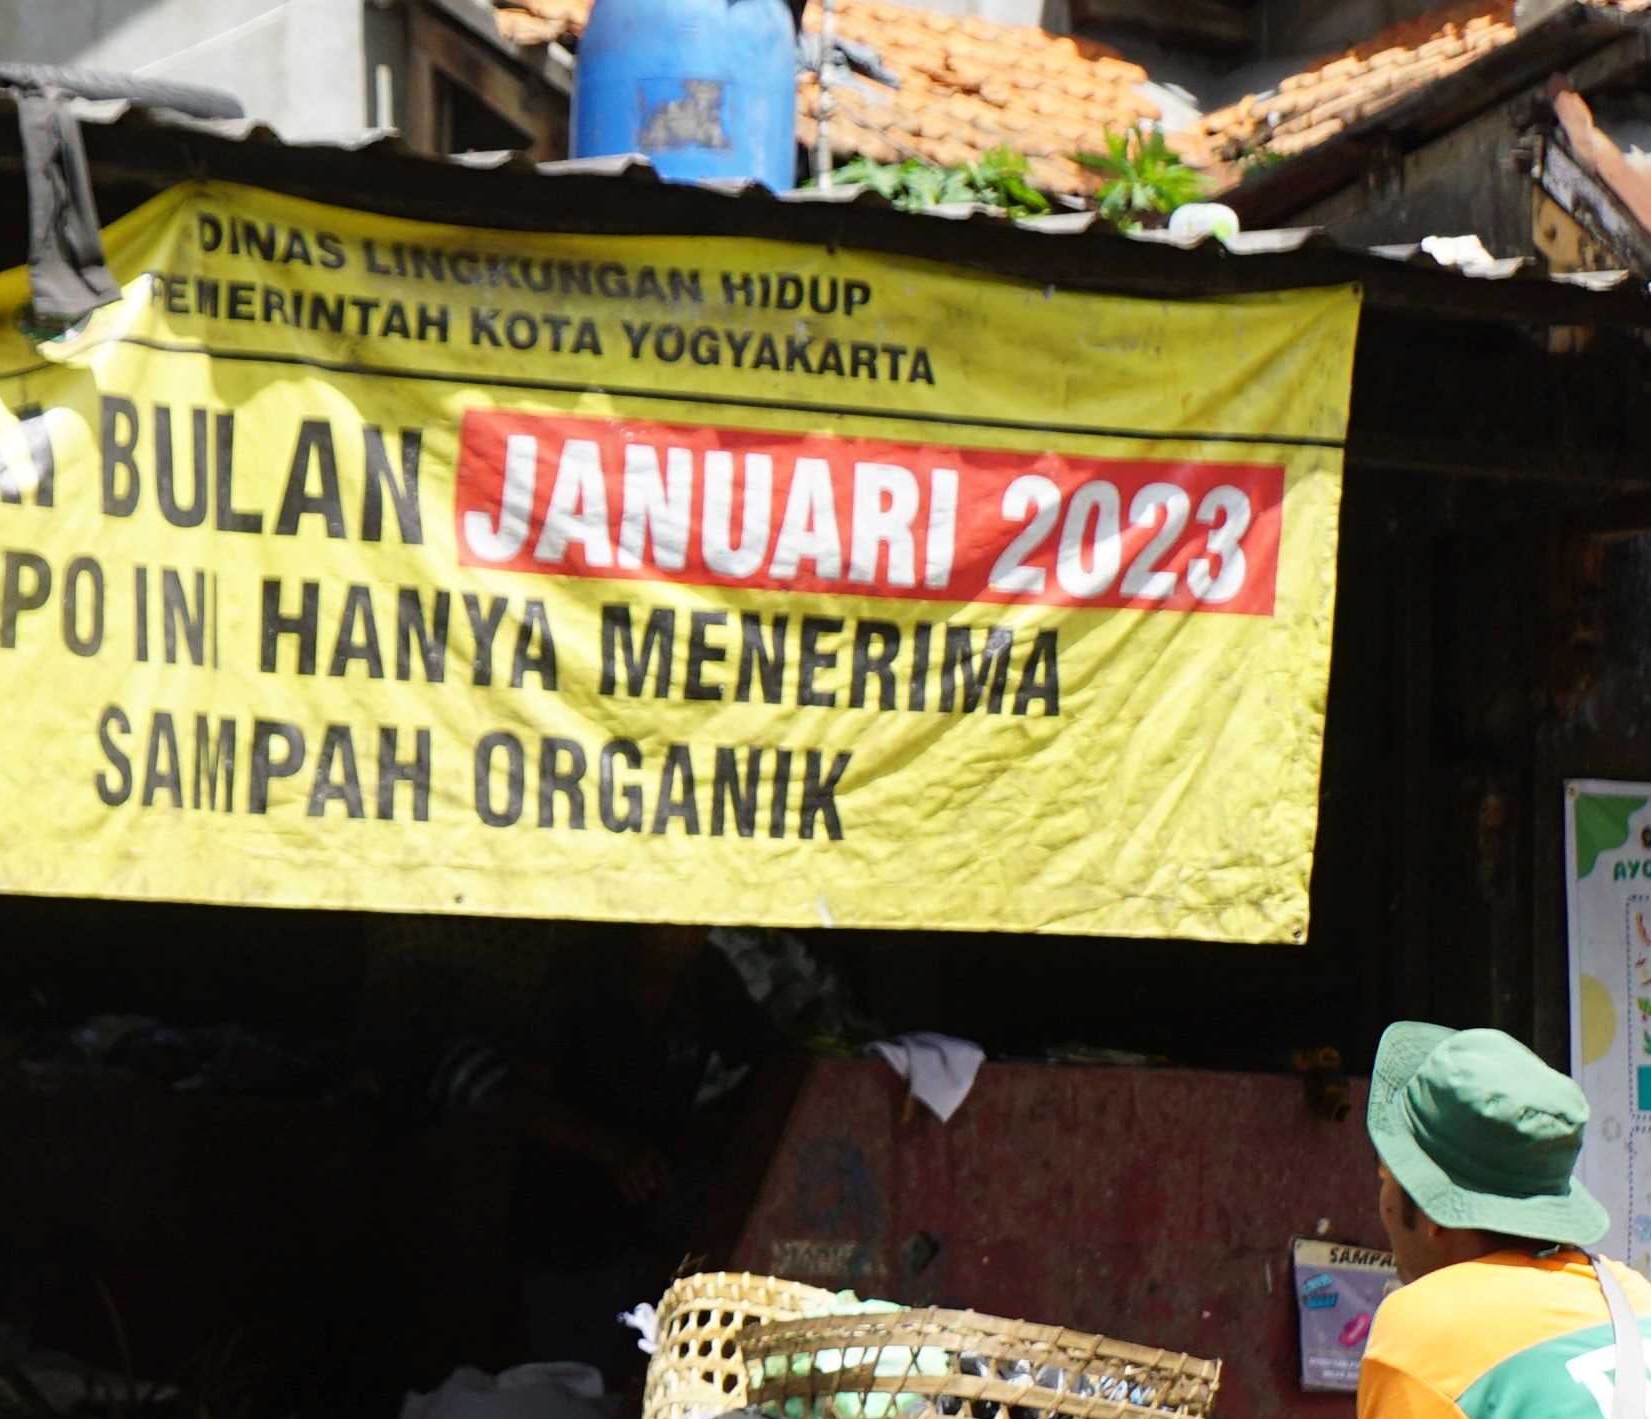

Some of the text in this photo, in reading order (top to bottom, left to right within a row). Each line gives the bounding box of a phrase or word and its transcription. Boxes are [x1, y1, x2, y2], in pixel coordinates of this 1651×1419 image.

[199, 211, 872, 318] DINAS LINGKUNGAN HIDUP
[469, 311, 602, 360] KOTA
[628, 319, 936, 387] YOGYAKARTA
[100, 395, 424, 545] BULAN
[463, 433, 959, 592] JANUARI
[986, 473, 1252, 606] 2023
[260, 577, 559, 694] HANYA
[599, 605, 1063, 718] MENERIMA
[95, 704, 853, 843] SAMPAH ORGANIK
